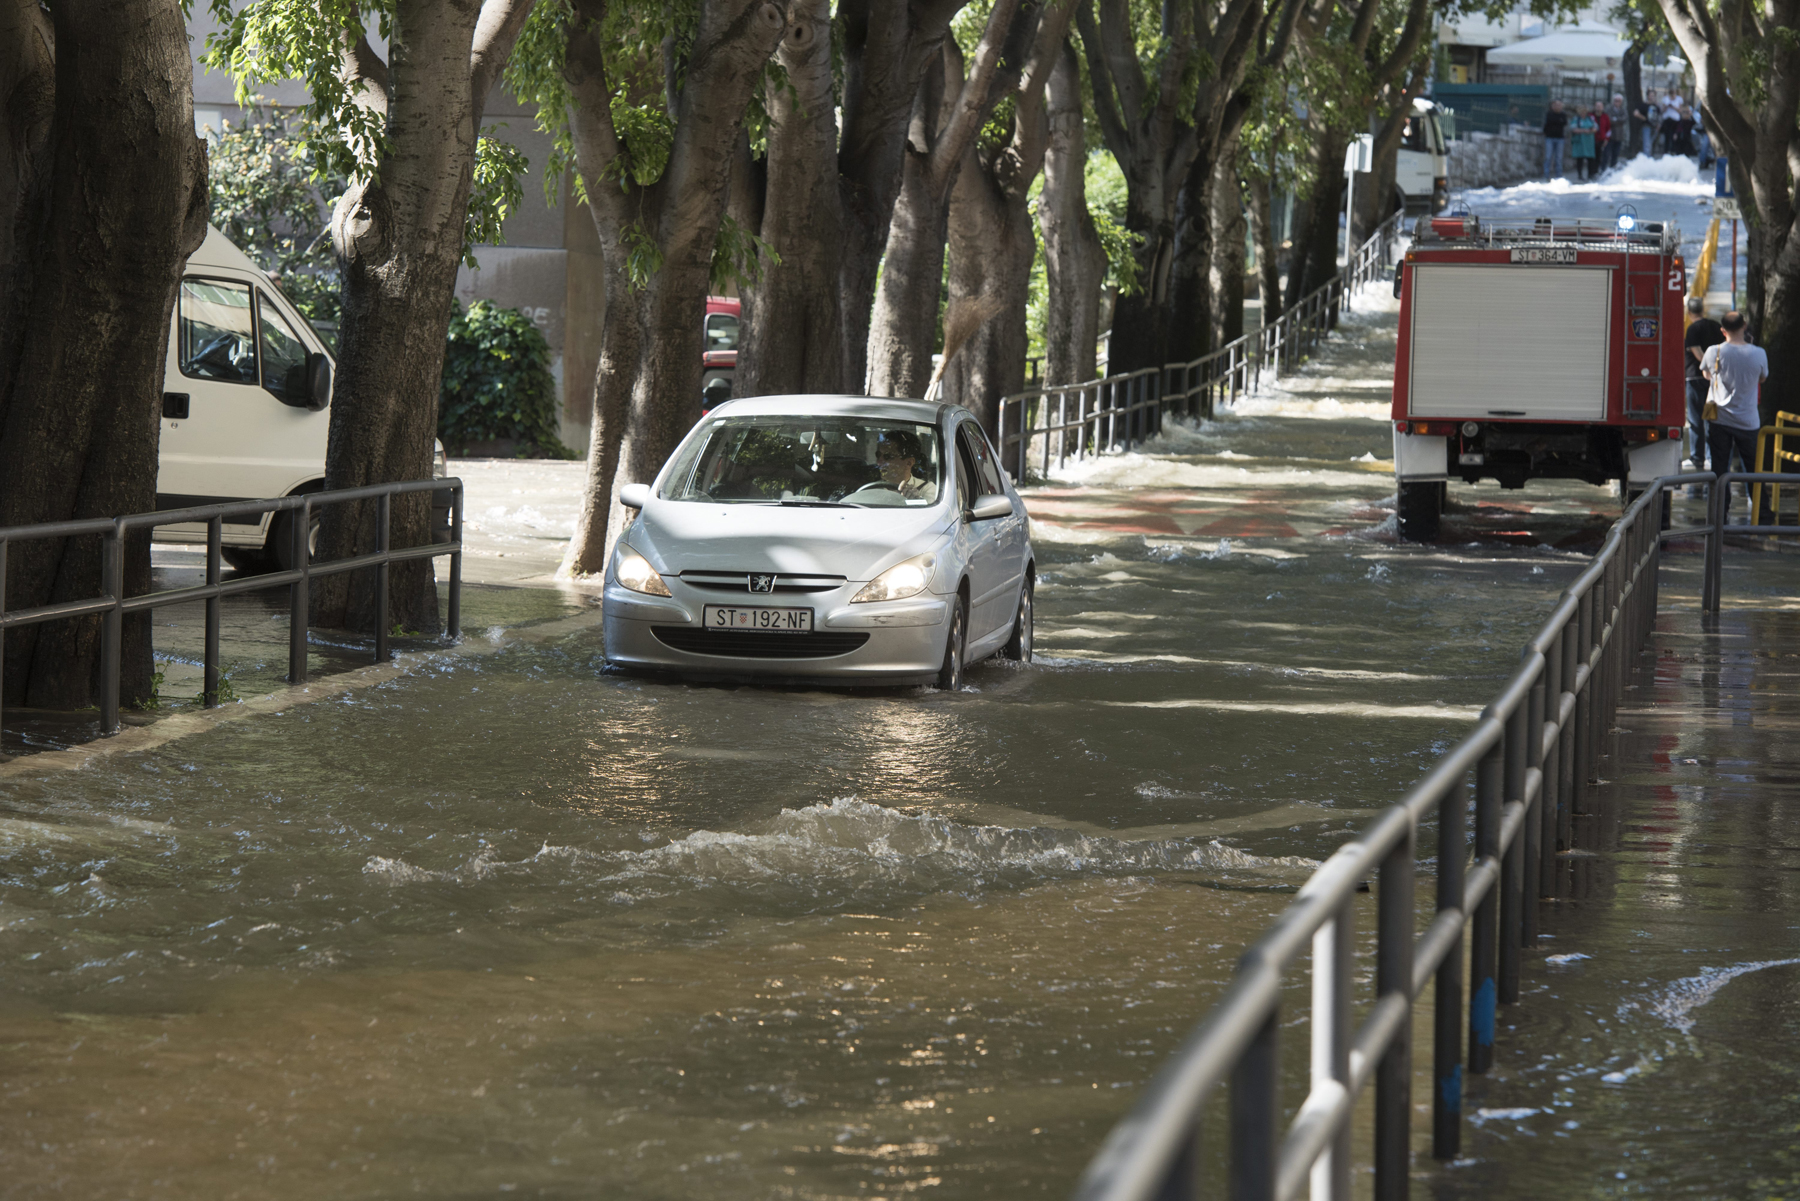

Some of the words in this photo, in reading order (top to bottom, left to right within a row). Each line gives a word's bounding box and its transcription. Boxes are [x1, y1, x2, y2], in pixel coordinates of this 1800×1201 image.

[1518, 250, 1530, 261] ST
[1538, 250, 1575, 261] 364-VM
[1668, 270, 1682, 291] 2
[716, 609, 737, 626] ST
[752, 610, 808, 629] 192-NF
